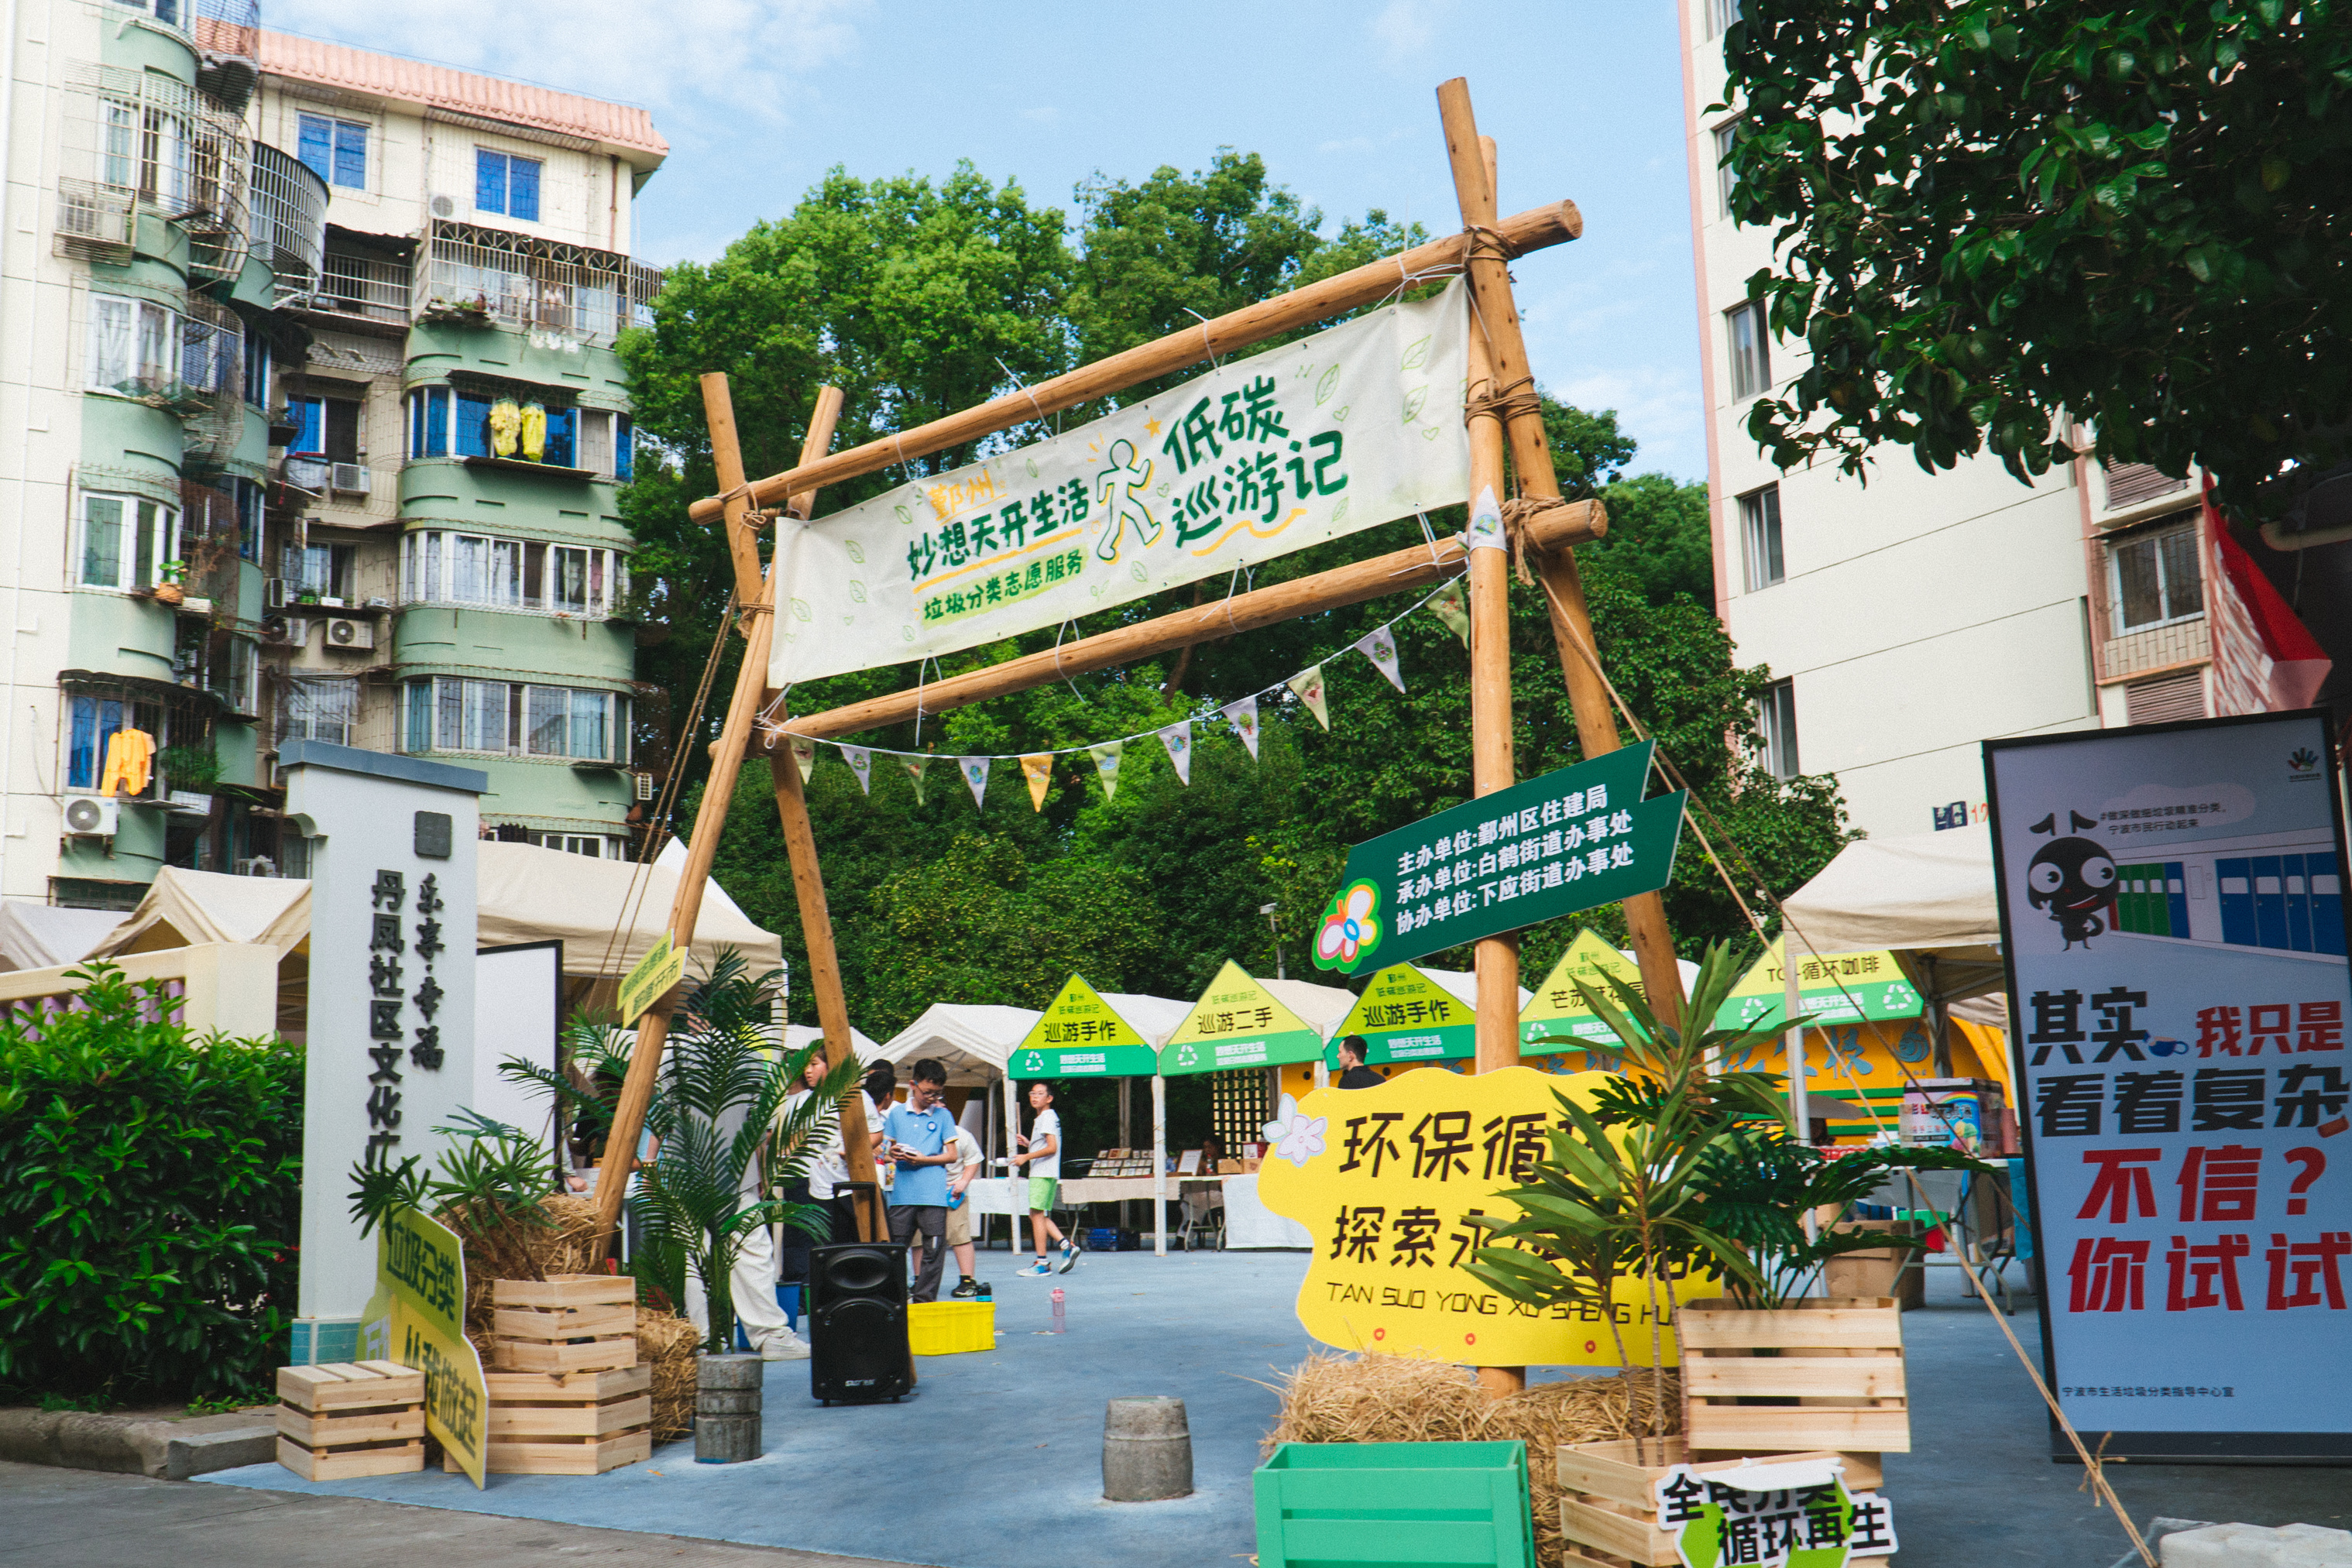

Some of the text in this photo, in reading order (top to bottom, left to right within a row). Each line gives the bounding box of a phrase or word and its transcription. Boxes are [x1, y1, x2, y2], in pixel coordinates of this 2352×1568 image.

[1162, 375, 1290, 475] 低碳
[927, 468, 995, 521] 鄞州
[1171, 430, 1348, 548] 巡游记
[907, 478, 1090, 582] 妙想天开生活
[924, 548, 1083, 621] 垃圾分类志愿服务
[1396, 784, 1609, 876] 主办单位:鄞州区住建局
[1396, 808, 1634, 905] 承办单位:白鹤街道办事处
[1396, 841, 1636, 935] 协办单位:下应街道办事处
[366, 869, 407, 1173] 丹凤社区文化广
[1043, 1020, 1117, 1043] 巡游手作
[1197, 1006, 1273, 1034] 巡游二手
[1361, 999, 1451, 1028] 巡游手作
[2028, 986, 2347, 1066] 其实 我只是
[2034, 1063, 2352, 1138] 看着复杂
[1339, 1110, 1622, 1183] 环保循
[1330, 1205, 1690, 1282] 探索永
[2066, 1231, 2352, 1313] 你试试
[1327, 1282, 1374, 1304] TAN
[1381, 1287, 1425, 1309] SUO
[1437, 1290, 1499, 1315] YONG
[1640, 1304, 1682, 1326] HU
[1717, 1502, 1890, 1565] 循环再生
